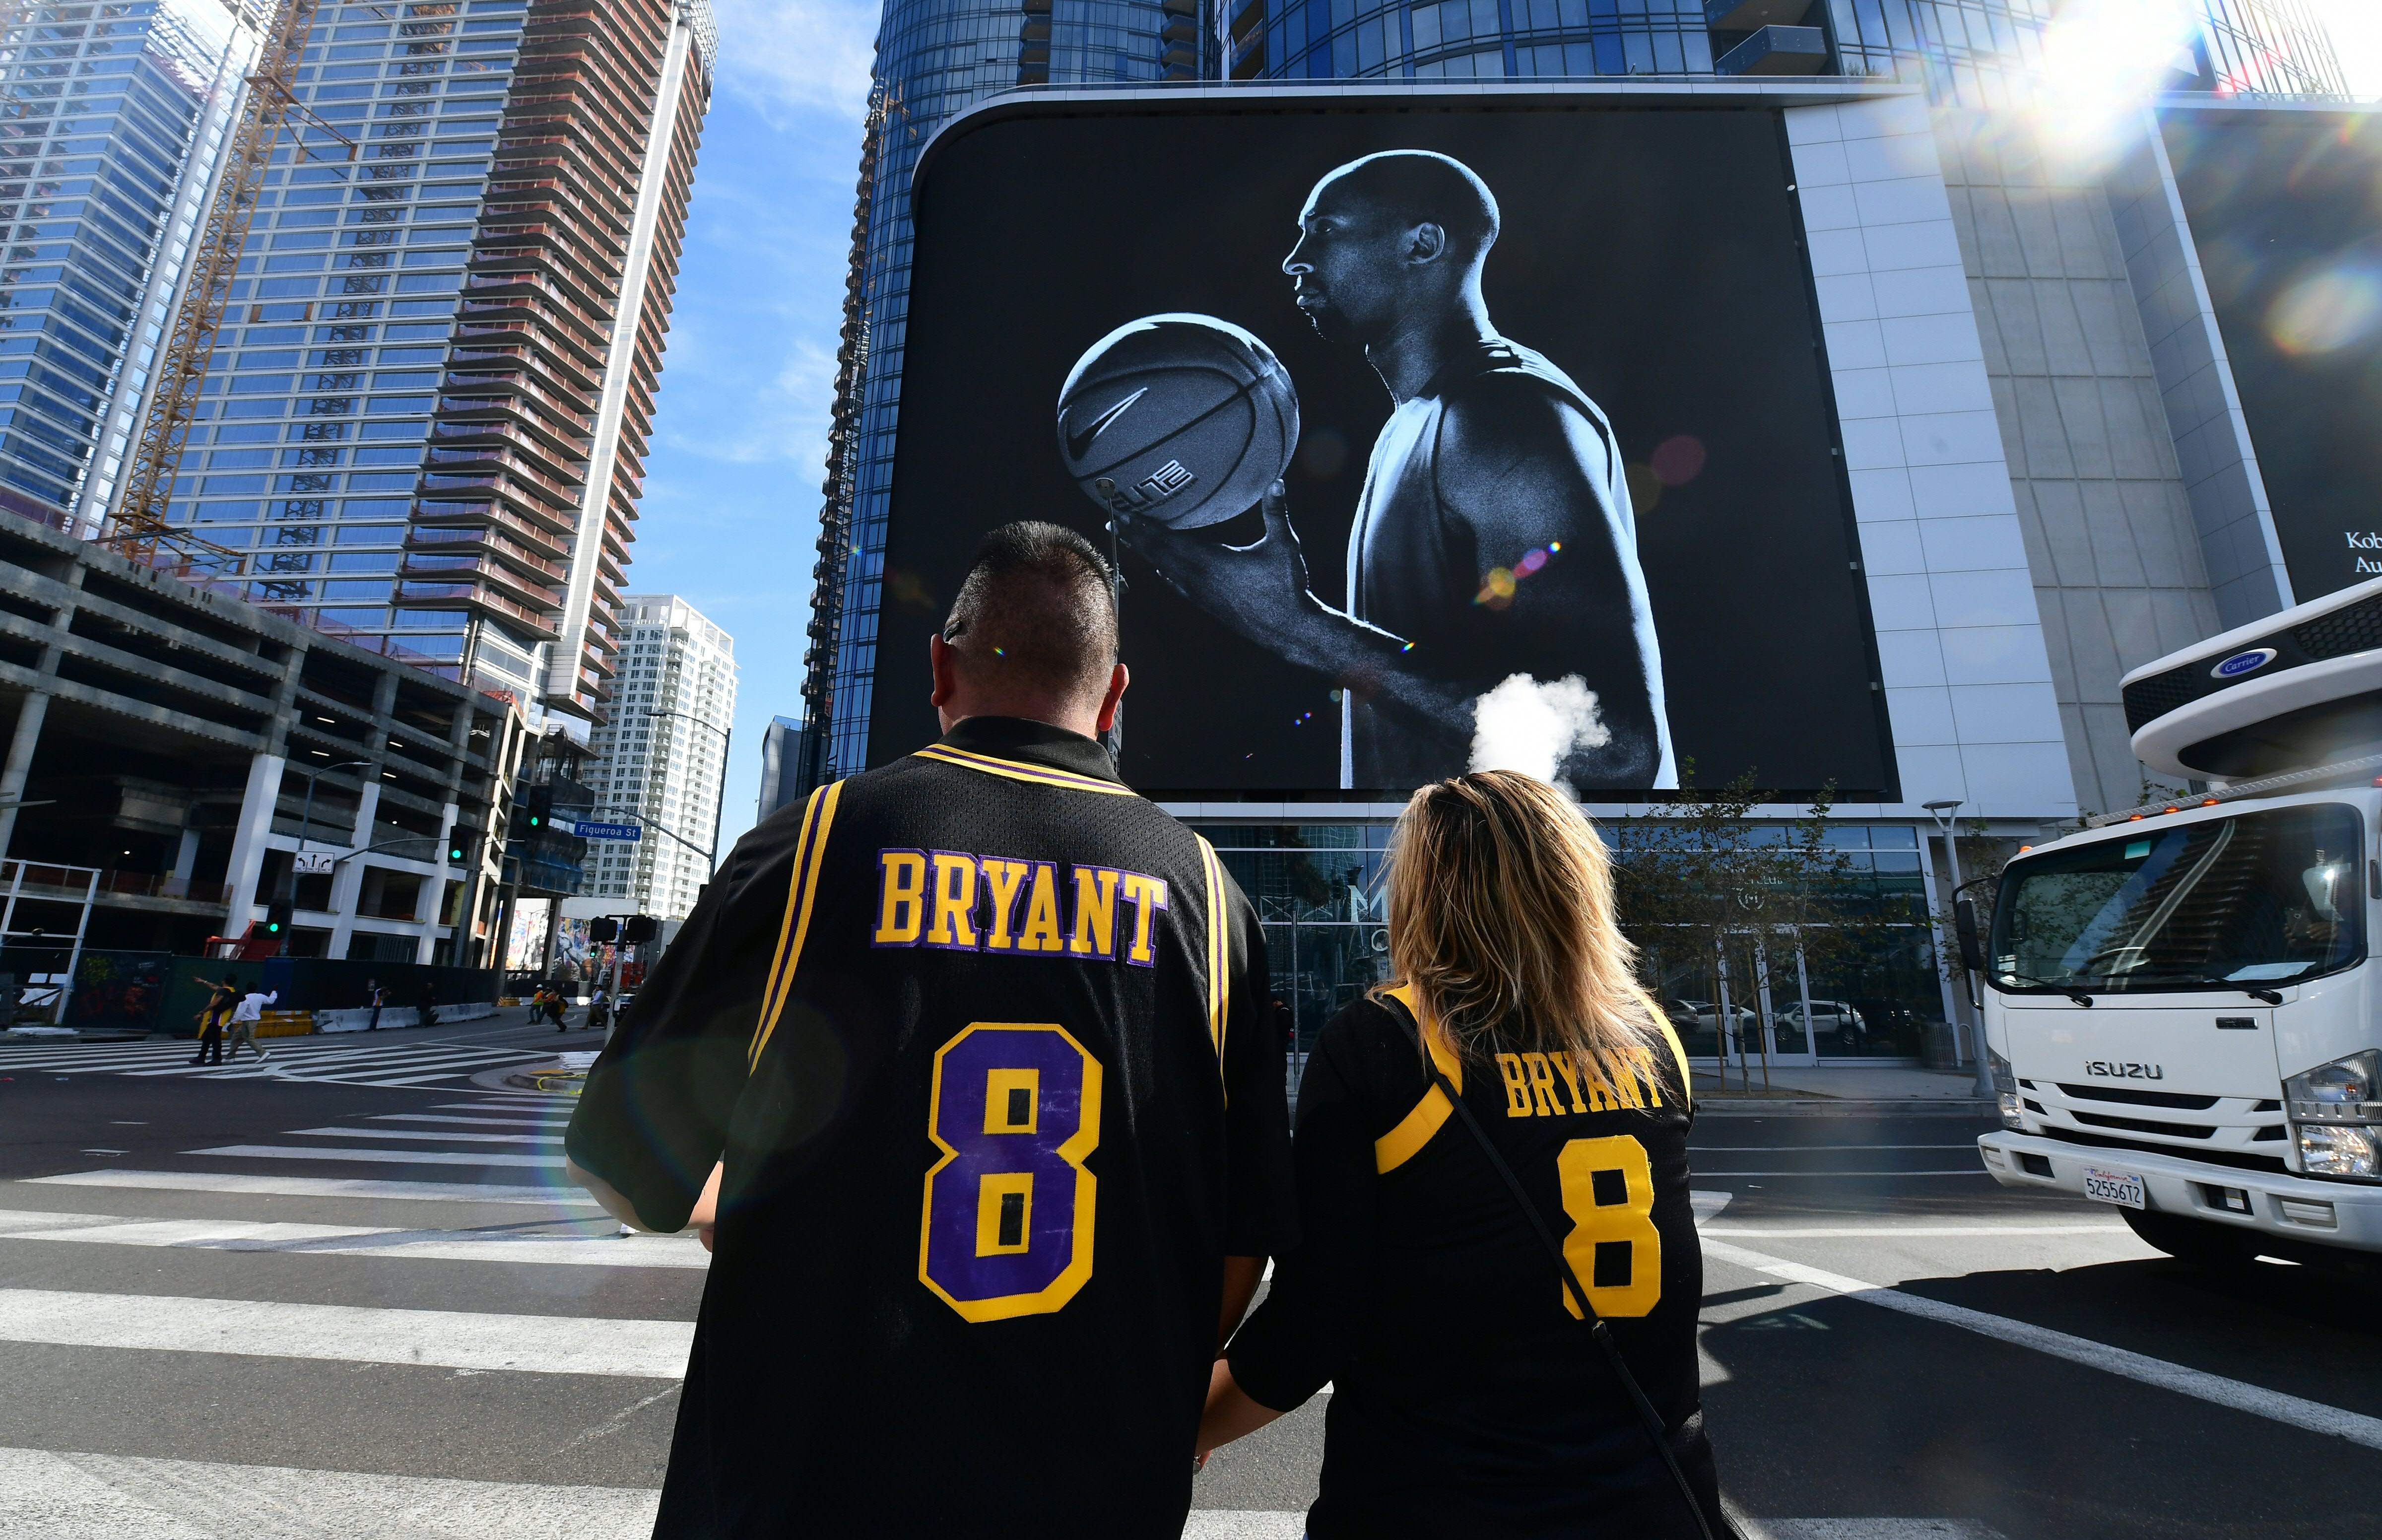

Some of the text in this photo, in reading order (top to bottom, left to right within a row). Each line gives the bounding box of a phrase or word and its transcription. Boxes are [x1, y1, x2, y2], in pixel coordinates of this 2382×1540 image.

[2225, 656, 2259, 671] Carrier
[580, 825, 636, 837] Figueroa St
[870, 848, 1168, 968] BRYANT
[1495, 1046, 1662, 1118] BRYANT
[919, 1022, 1103, 1323] 8
[2086, 1178, 2141, 1204] 52556T2
[1557, 1135, 1661, 1320] 8
